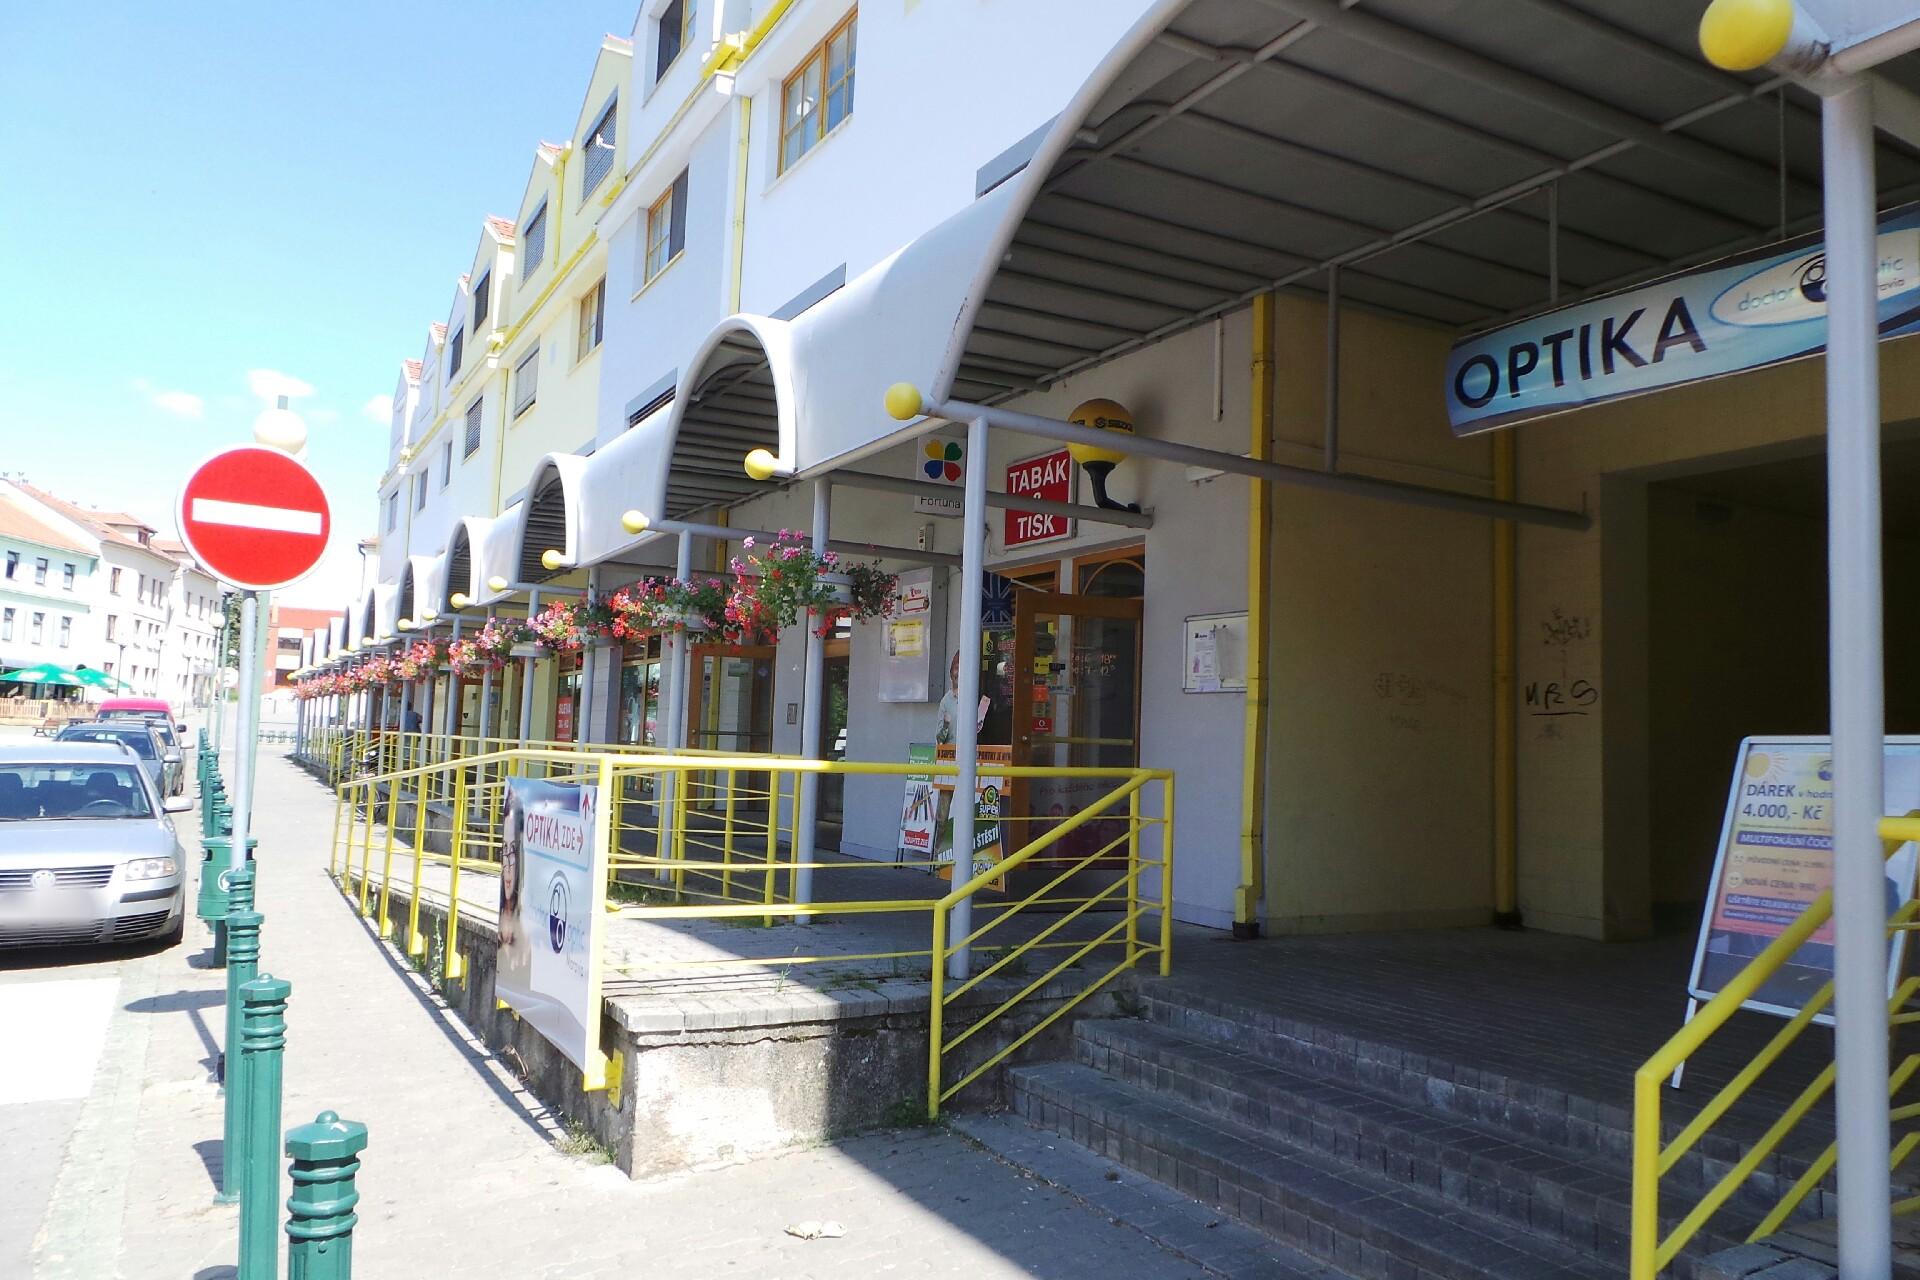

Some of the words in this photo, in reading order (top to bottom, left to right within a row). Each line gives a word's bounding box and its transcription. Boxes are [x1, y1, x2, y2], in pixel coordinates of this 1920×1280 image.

[1738, 286, 1797, 312] doctor
[1454, 296, 1707, 408] OPTIKA
[1009, 458, 1068, 494] TABÁK
[920, 496, 961, 509] Fortuna
[1017, 514, 1055, 539] TISK
[1746, 780, 1796, 798] DÁREK
[1743, 803, 1799, 821] 4.000,-
[1802, 804, 1825, 820] Kč
[526, 811, 560, 851] OPTIKA
[561, 825, 576, 851] ZDE
